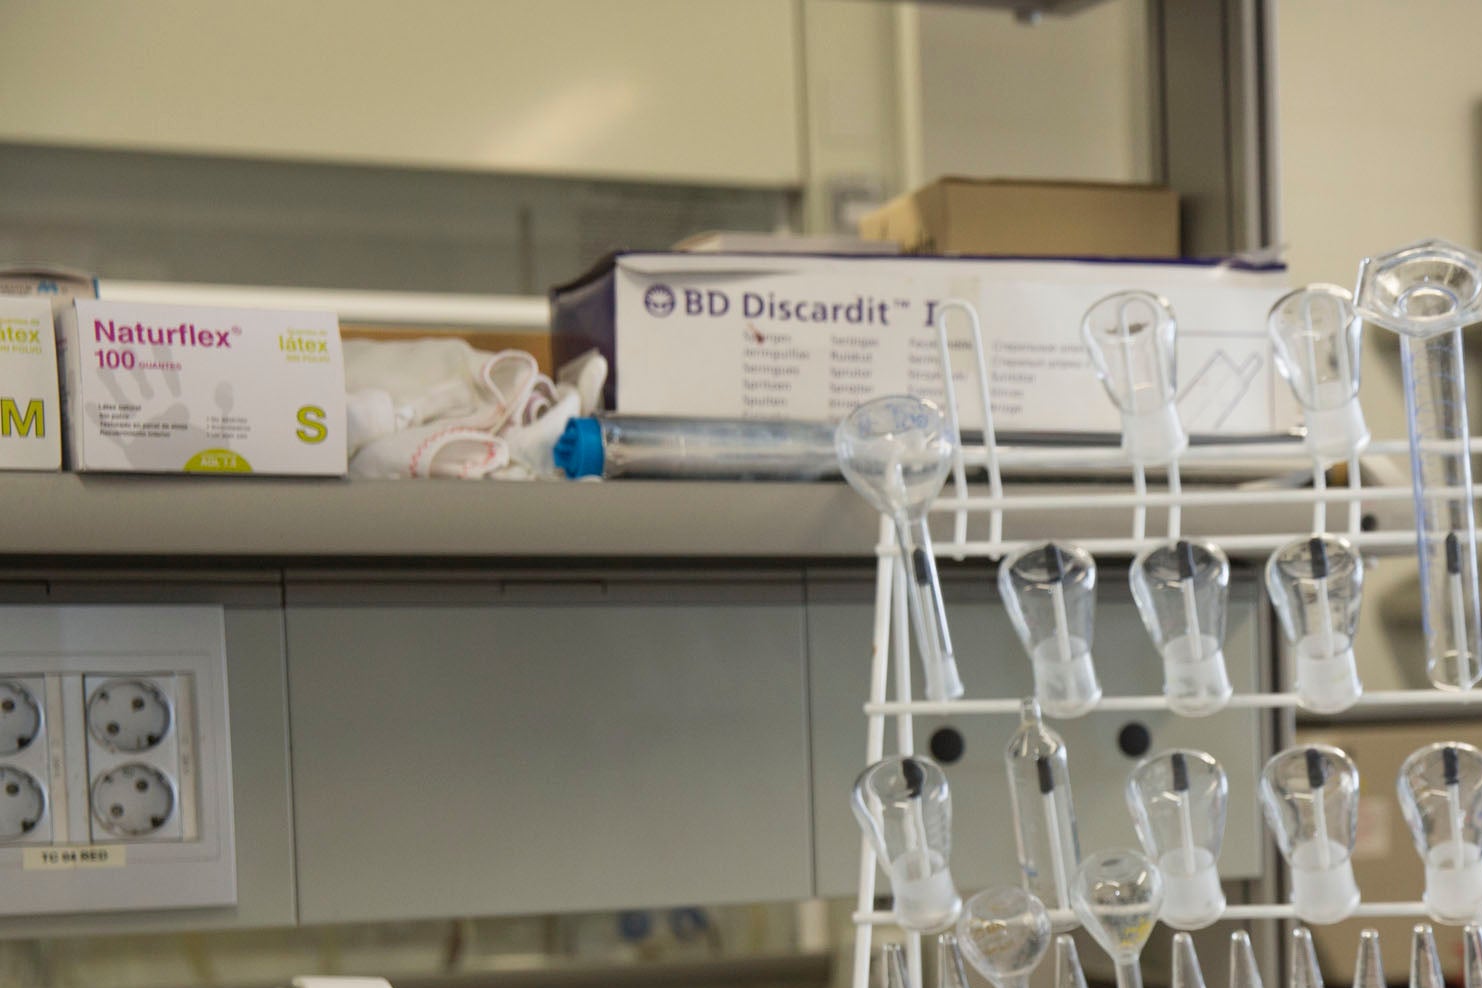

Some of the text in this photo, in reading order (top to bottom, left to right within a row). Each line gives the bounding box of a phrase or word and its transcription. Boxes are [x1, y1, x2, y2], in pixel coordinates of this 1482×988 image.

[684, 288, 730, 318] BD
[0, 325, 40, 344] tex
[95, 349, 136, 371] 100
[0, 396, 46, 438] M
[296, 404, 328, 444] S
